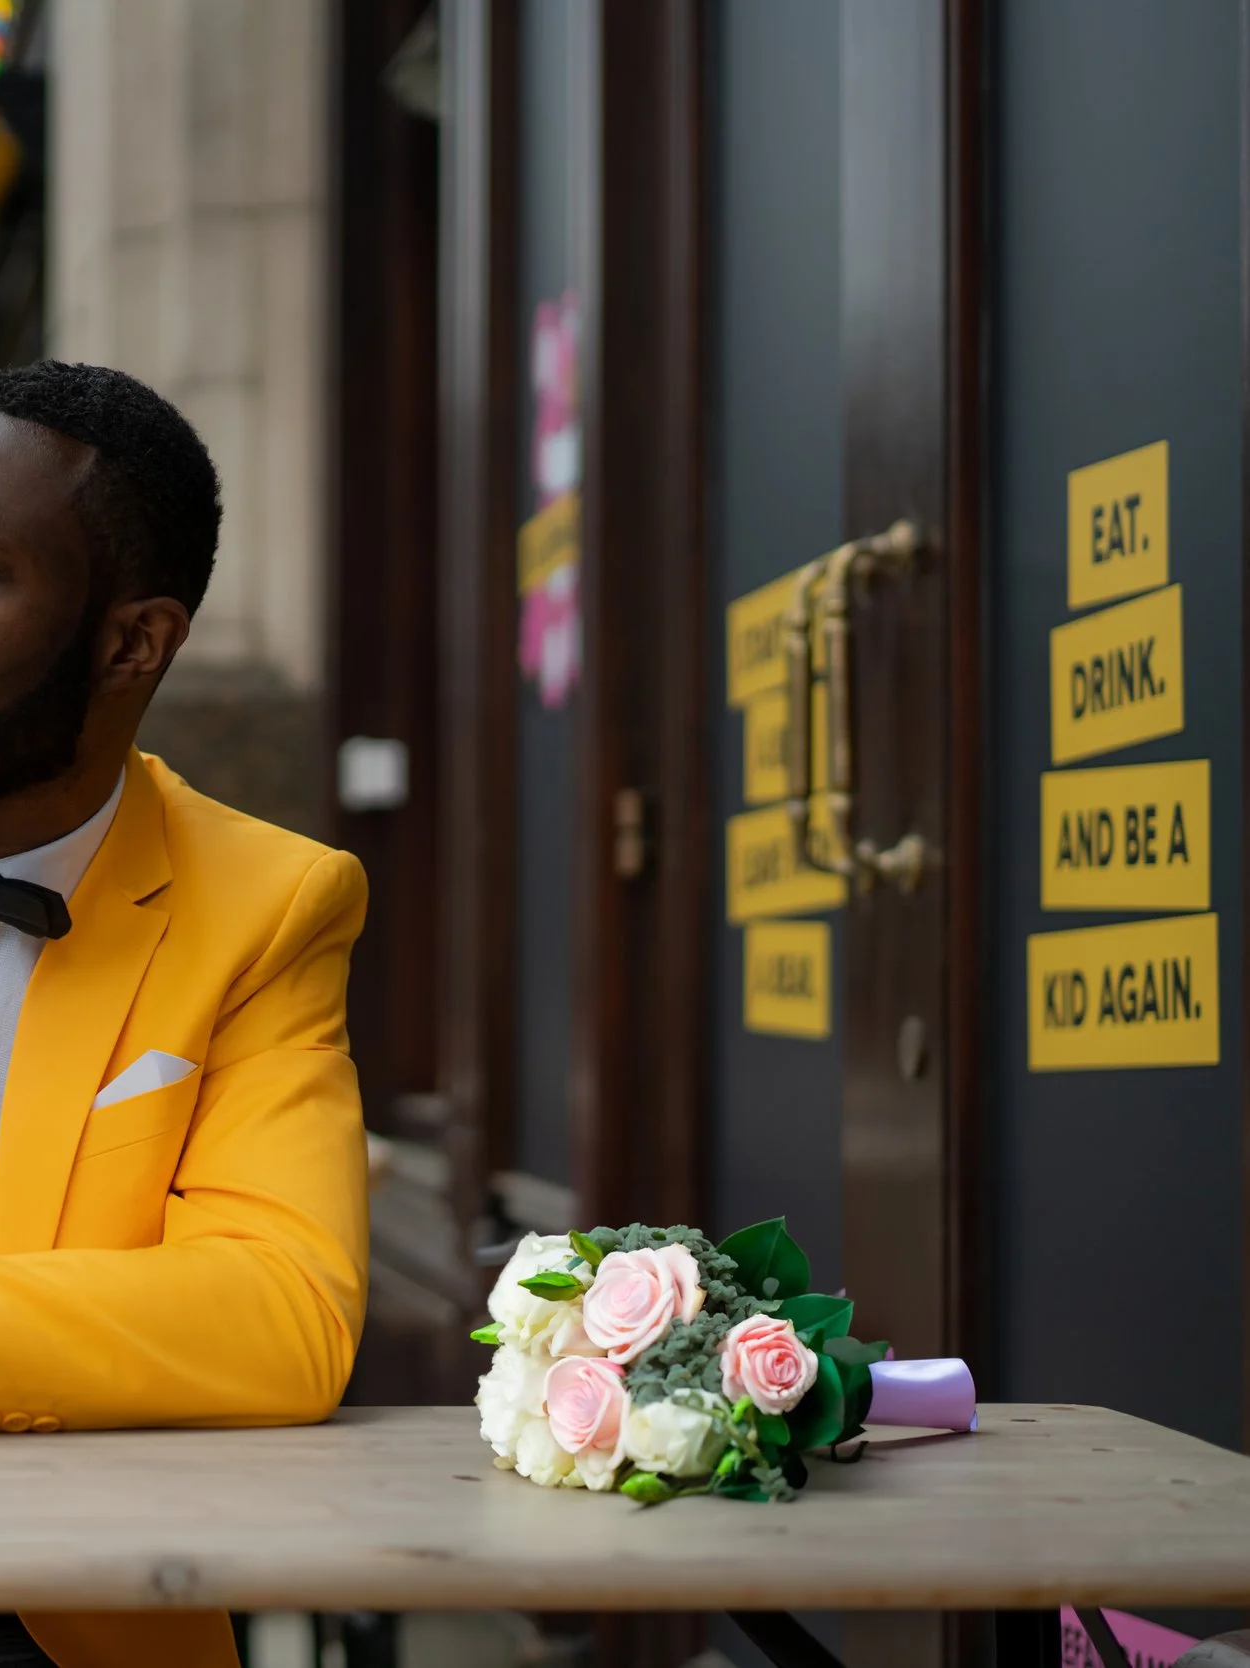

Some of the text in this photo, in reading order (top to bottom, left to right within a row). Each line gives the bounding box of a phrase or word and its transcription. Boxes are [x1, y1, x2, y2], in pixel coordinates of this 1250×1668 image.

[1091, 493, 1150, 566] EAT.
[1072, 636, 1167, 721] DRINK.
[1057, 801, 1190, 869] AND BE A
[1043, 956, 1202, 1028] KID AGAIN.
